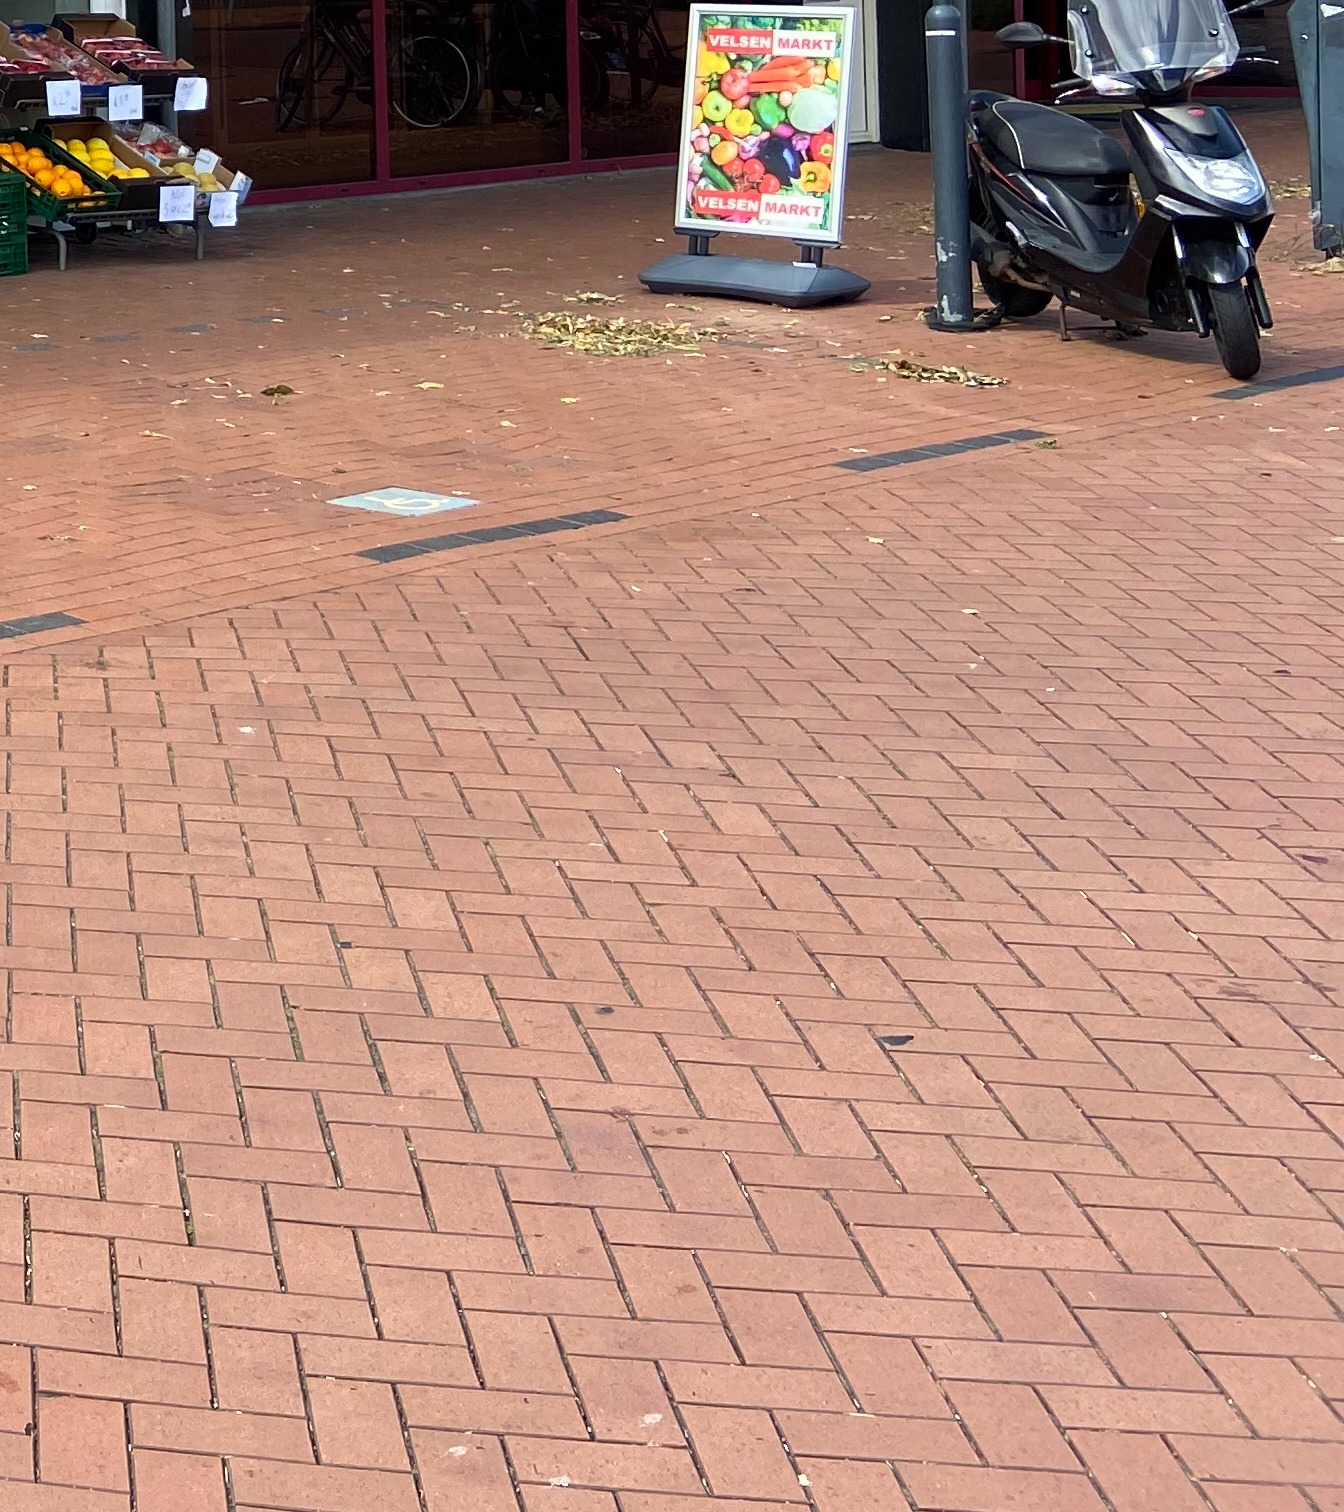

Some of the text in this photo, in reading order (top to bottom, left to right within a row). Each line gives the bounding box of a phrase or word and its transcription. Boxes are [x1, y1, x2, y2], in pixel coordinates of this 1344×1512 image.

[708, 34, 834, 51] VELSEN MARKT
[697, 196, 822, 217] VELSEN MARKT
